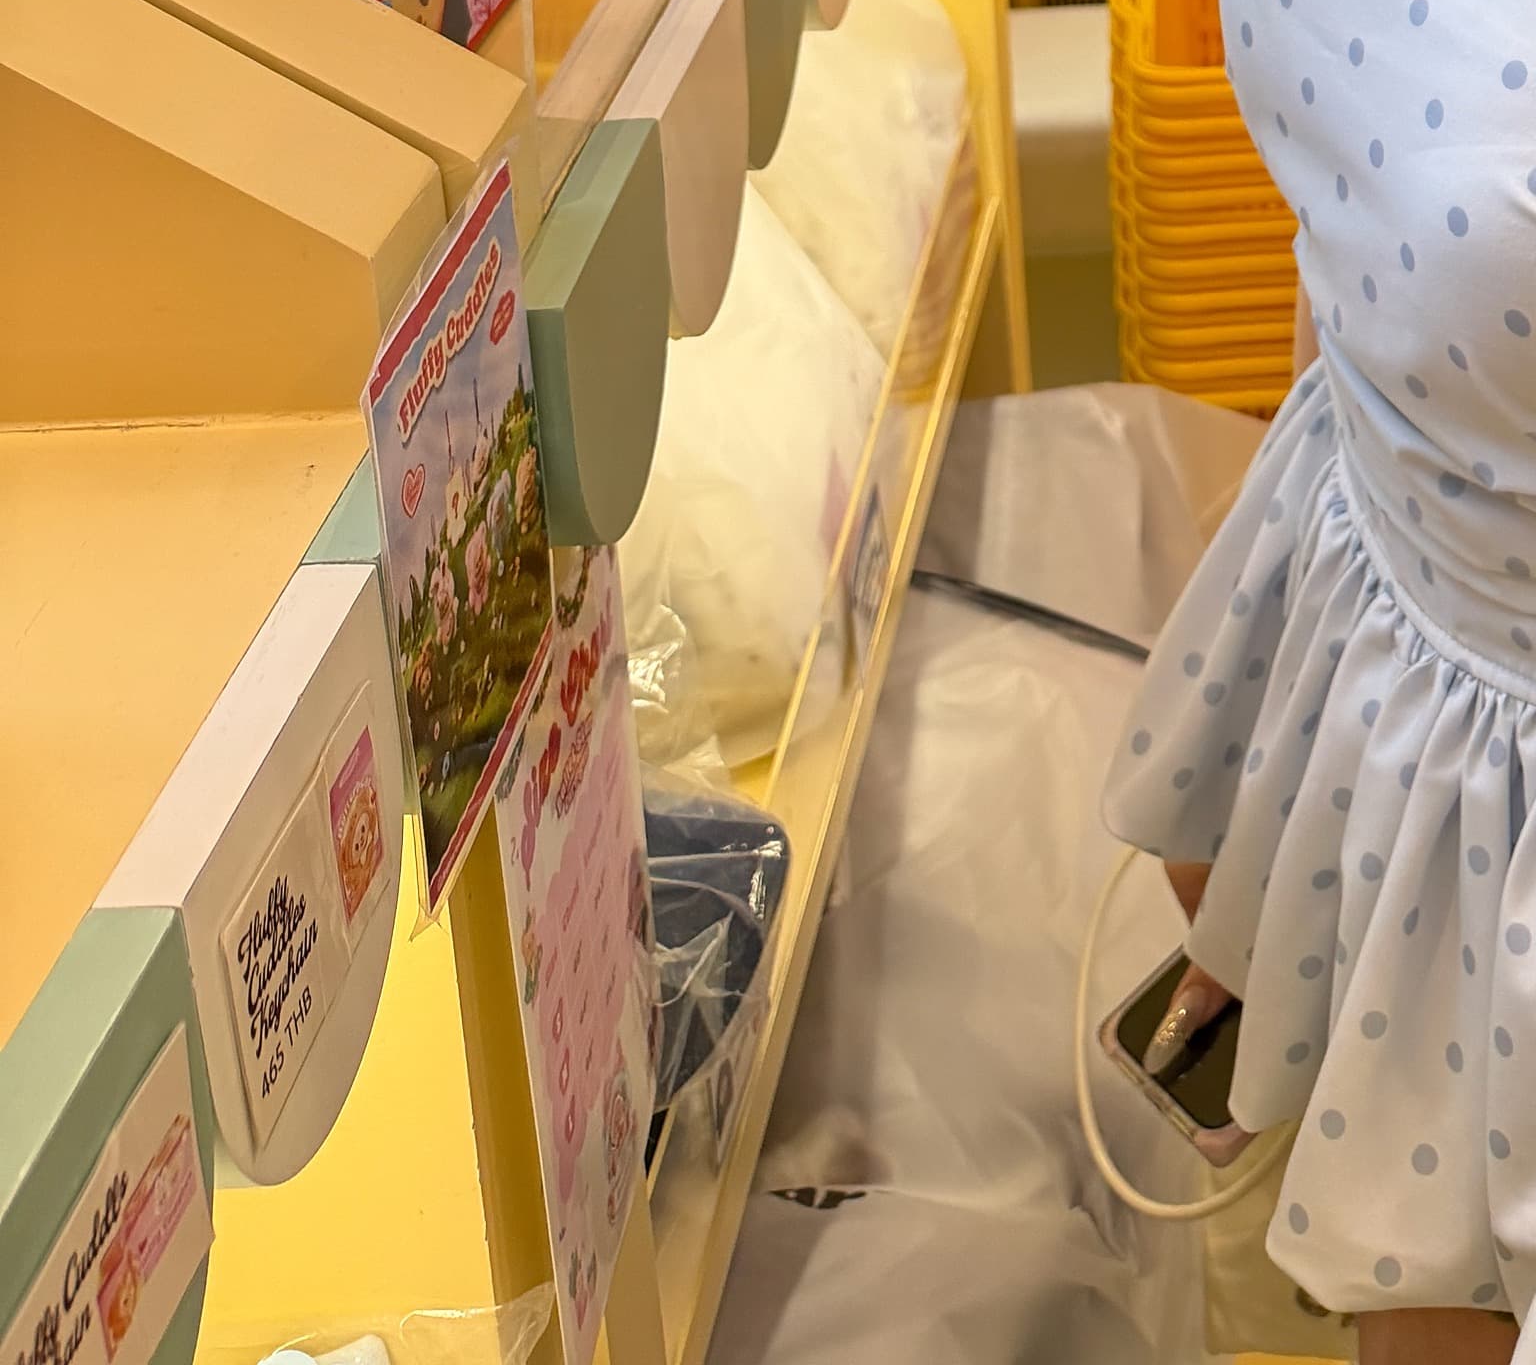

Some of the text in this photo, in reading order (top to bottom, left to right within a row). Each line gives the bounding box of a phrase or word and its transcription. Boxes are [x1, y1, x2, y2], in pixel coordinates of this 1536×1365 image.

[398, 333, 445, 437] Fluffy
[445, 241, 500, 352] Cuddles
[237, 874, 290, 983] Fluffy
[247, 894, 307, 1018] Cuddles
[251, 919, 319, 1059] Keychain
[261, 985, 312, 1099] 465 THB
